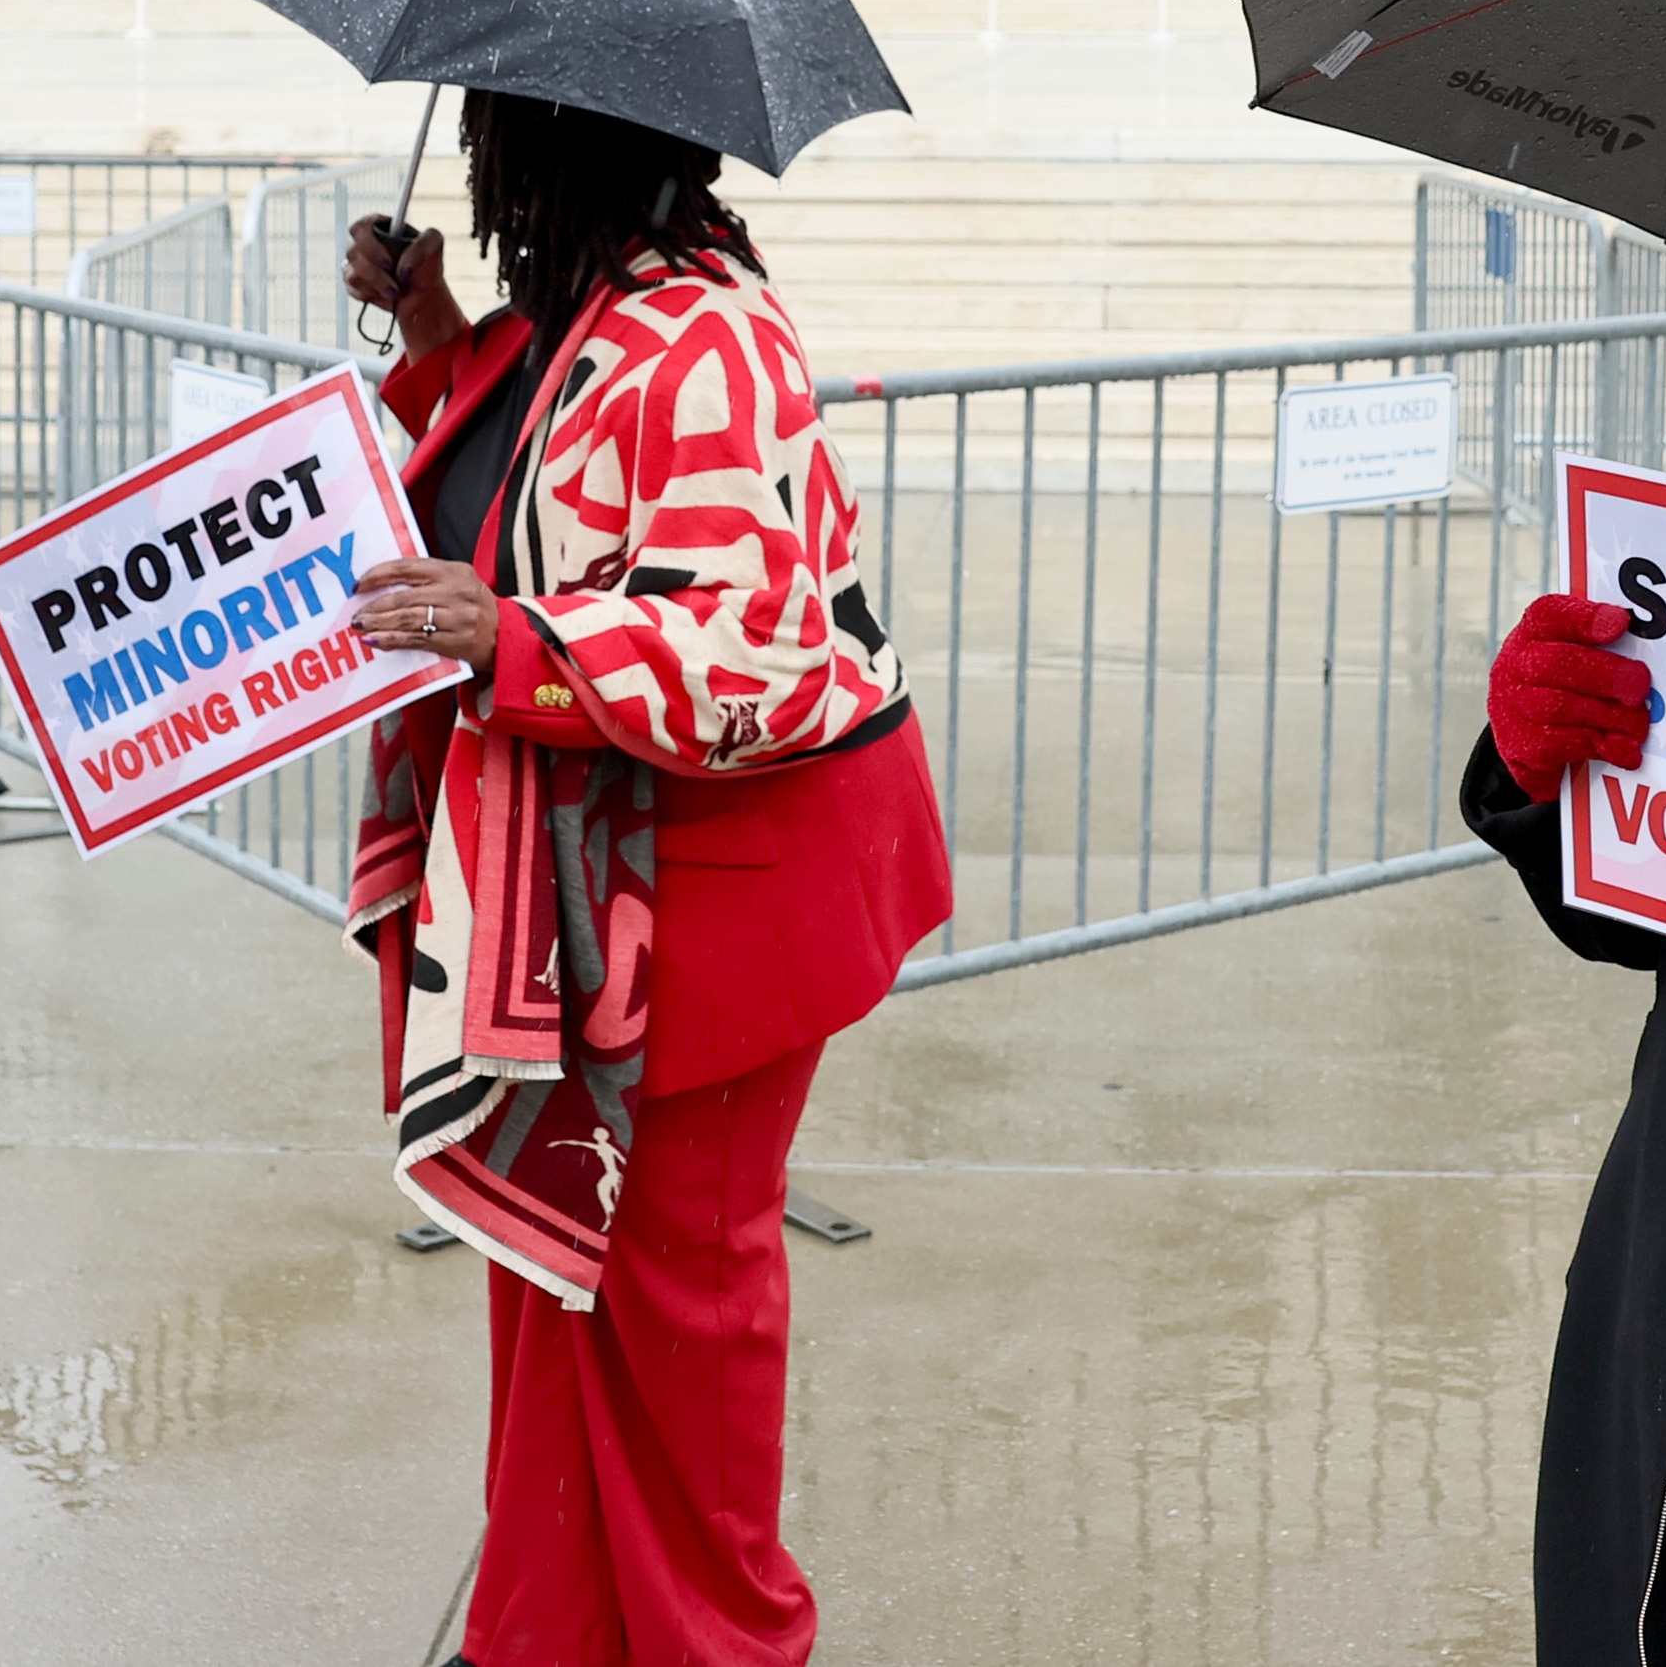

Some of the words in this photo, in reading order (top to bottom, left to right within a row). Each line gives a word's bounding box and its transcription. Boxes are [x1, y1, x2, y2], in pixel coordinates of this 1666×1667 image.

[1301, 404, 1359, 433] AREA
[1365, 396, 1439, 427] CLOSED
[31, 454, 326, 653] PROTECT
[63, 532, 358, 731] MINORITY
[81, 692, 240, 793] VOTING
[241, 625, 376, 717] RIGHT
